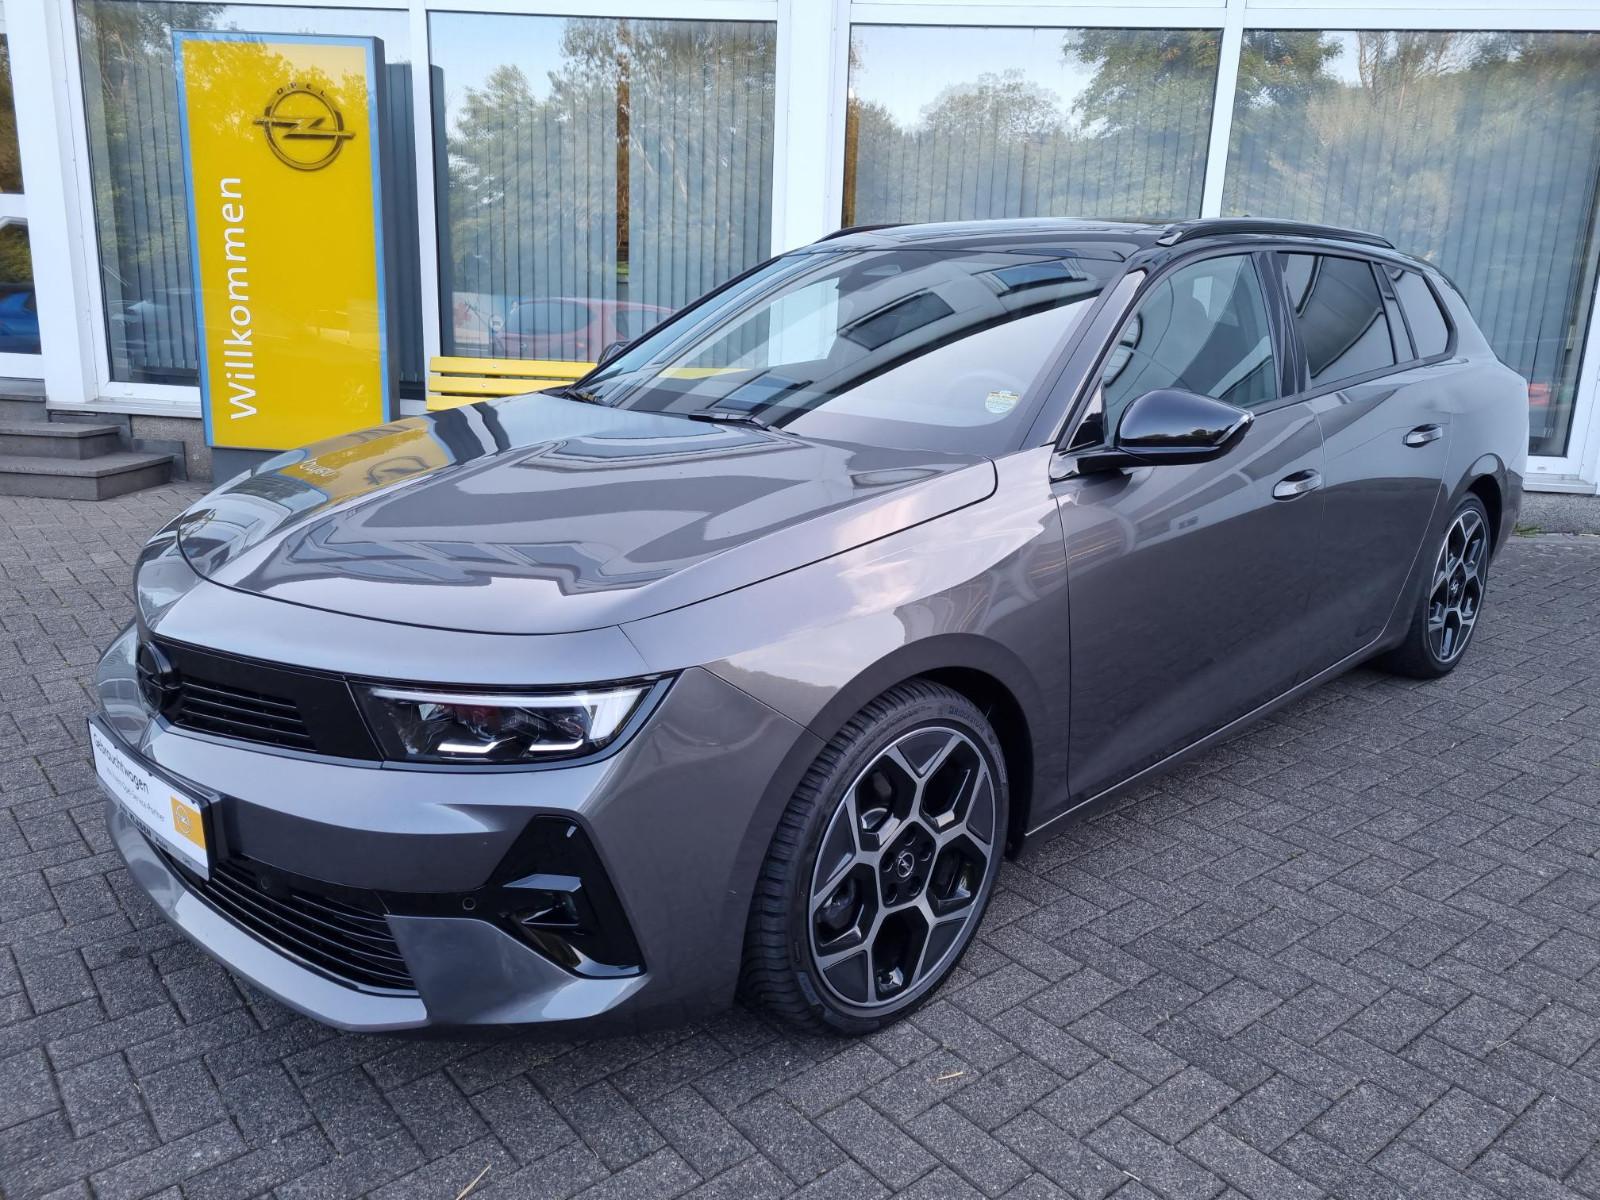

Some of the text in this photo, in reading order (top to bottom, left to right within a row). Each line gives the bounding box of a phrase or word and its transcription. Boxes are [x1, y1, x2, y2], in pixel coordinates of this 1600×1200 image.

[277, 82, 325, 97] OPEL
[220, 177, 257, 420] Willkommen
[93, 733, 149, 794] Gebrauchtwagen
